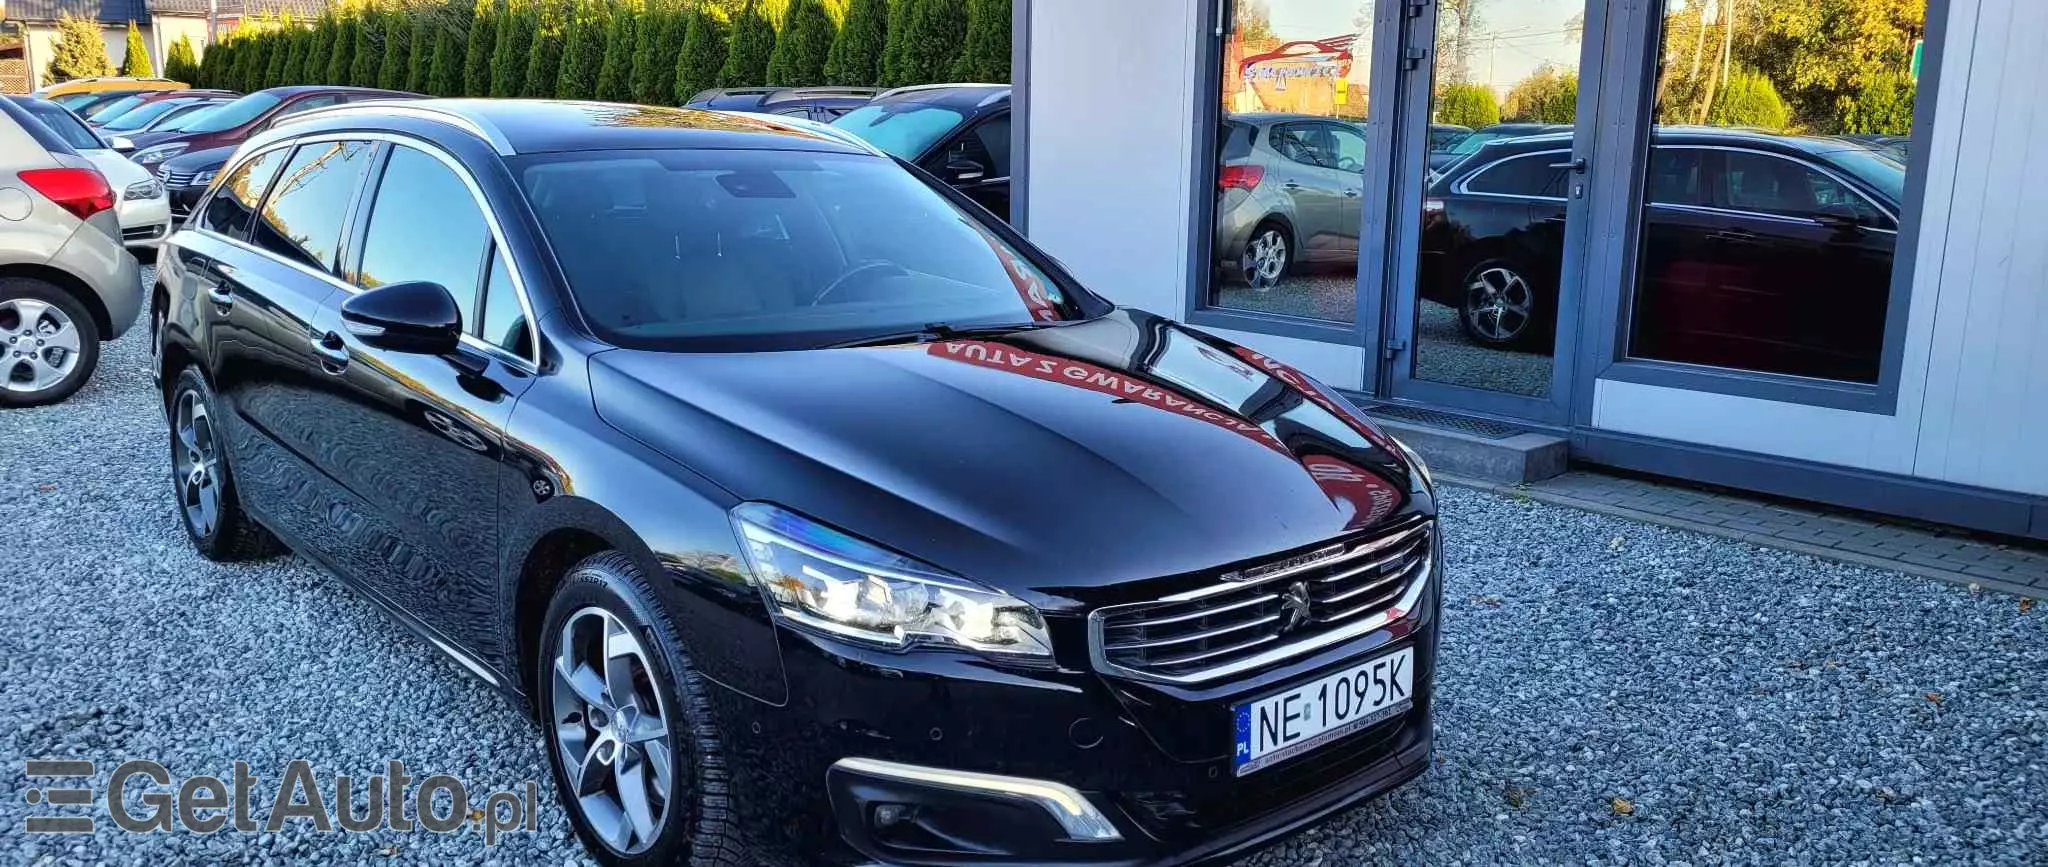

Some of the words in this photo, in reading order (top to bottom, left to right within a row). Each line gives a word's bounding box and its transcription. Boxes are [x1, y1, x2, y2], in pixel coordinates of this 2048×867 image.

[1260, 693, 1301, 752] NE
[1318, 654, 1406, 727] 1095K
[1236, 742, 1249, 757] PL
